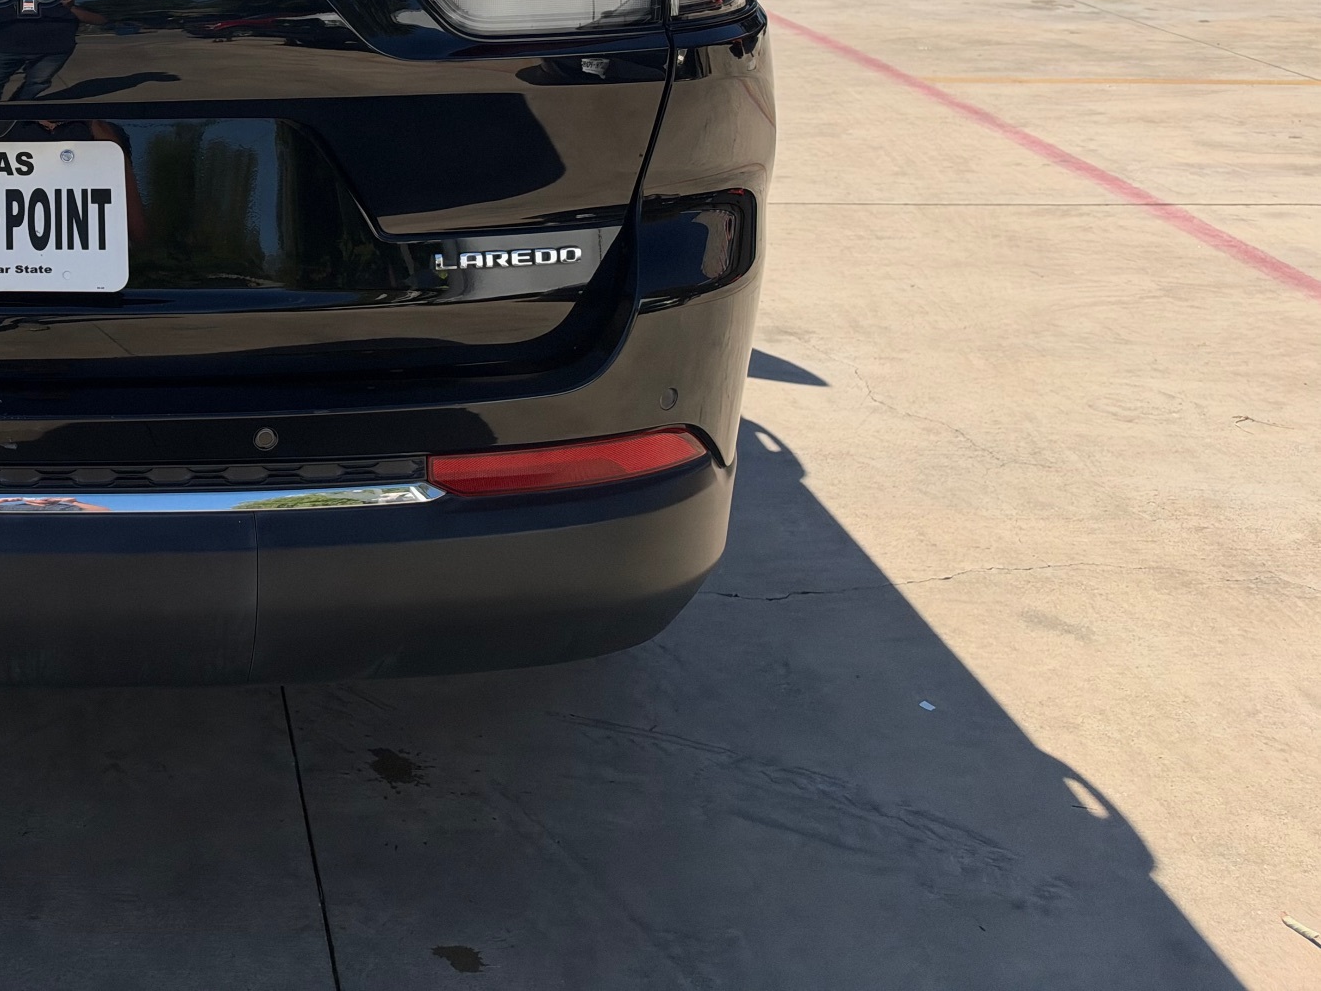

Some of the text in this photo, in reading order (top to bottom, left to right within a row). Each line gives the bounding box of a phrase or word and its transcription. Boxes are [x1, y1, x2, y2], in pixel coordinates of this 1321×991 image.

[5, 187, 112, 252] POINT
[14, 264, 53, 274] State
[434, 246, 583, 271] LAREDO
